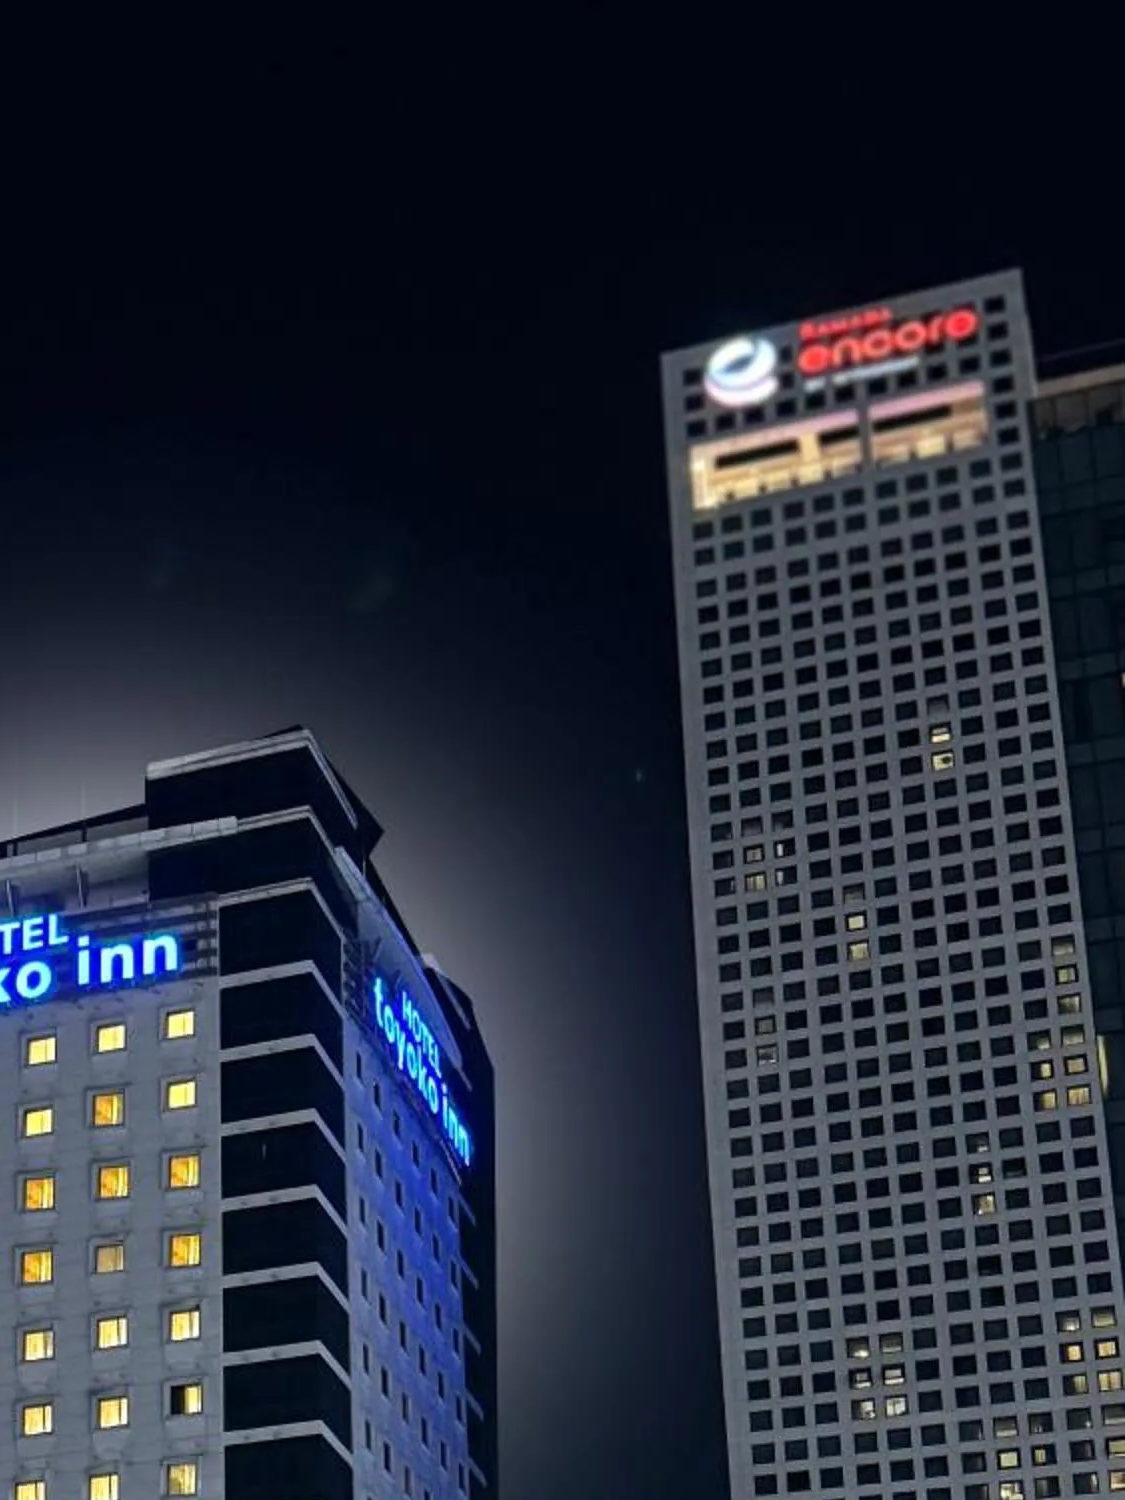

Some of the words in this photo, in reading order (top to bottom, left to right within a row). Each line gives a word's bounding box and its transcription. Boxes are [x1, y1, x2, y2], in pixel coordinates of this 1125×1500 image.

[798, 311, 978, 373] encore
[77, 934, 178, 986] inn
[373, 976, 440, 1115] toyoko
[441, 1083, 471, 1167] inn
[401, 991, 442, 1079] HOTEL
